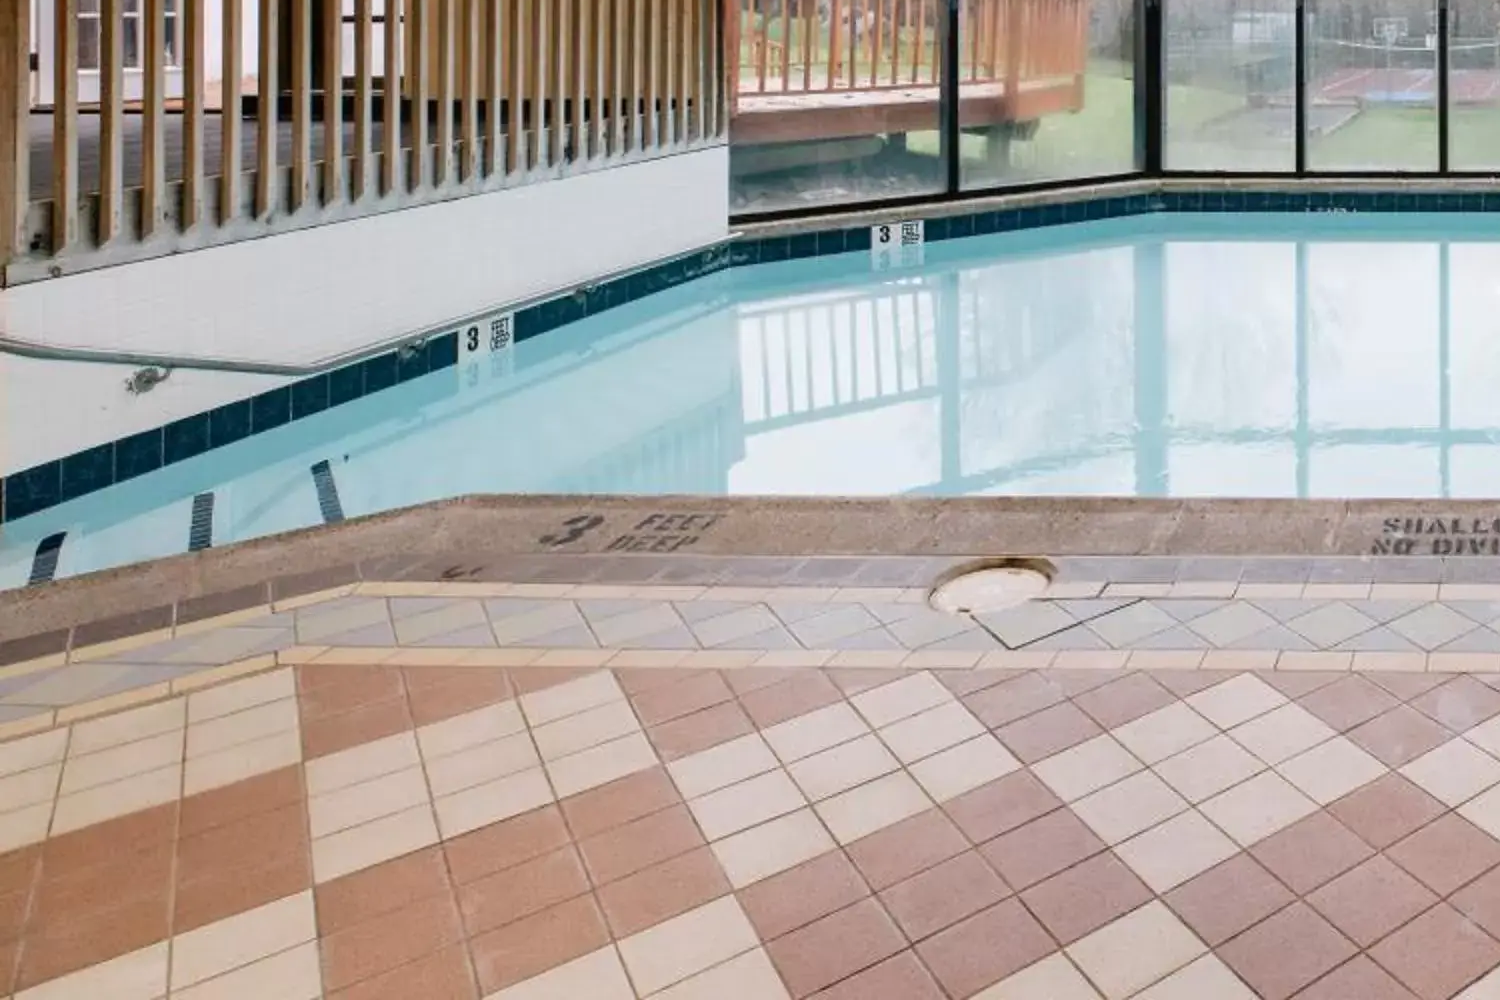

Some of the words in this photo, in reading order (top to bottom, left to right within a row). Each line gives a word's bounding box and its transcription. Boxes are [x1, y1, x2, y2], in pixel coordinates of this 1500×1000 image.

[879, 225, 891, 243] 3
[467, 326, 479, 352] 3
[491, 317, 509, 339] FEET
[538, 514, 605, 546] 3
[634, 513, 727, 532] FEET
[602, 535, 699, 552] DEEP
[1371, 539, 1417, 556] NO
